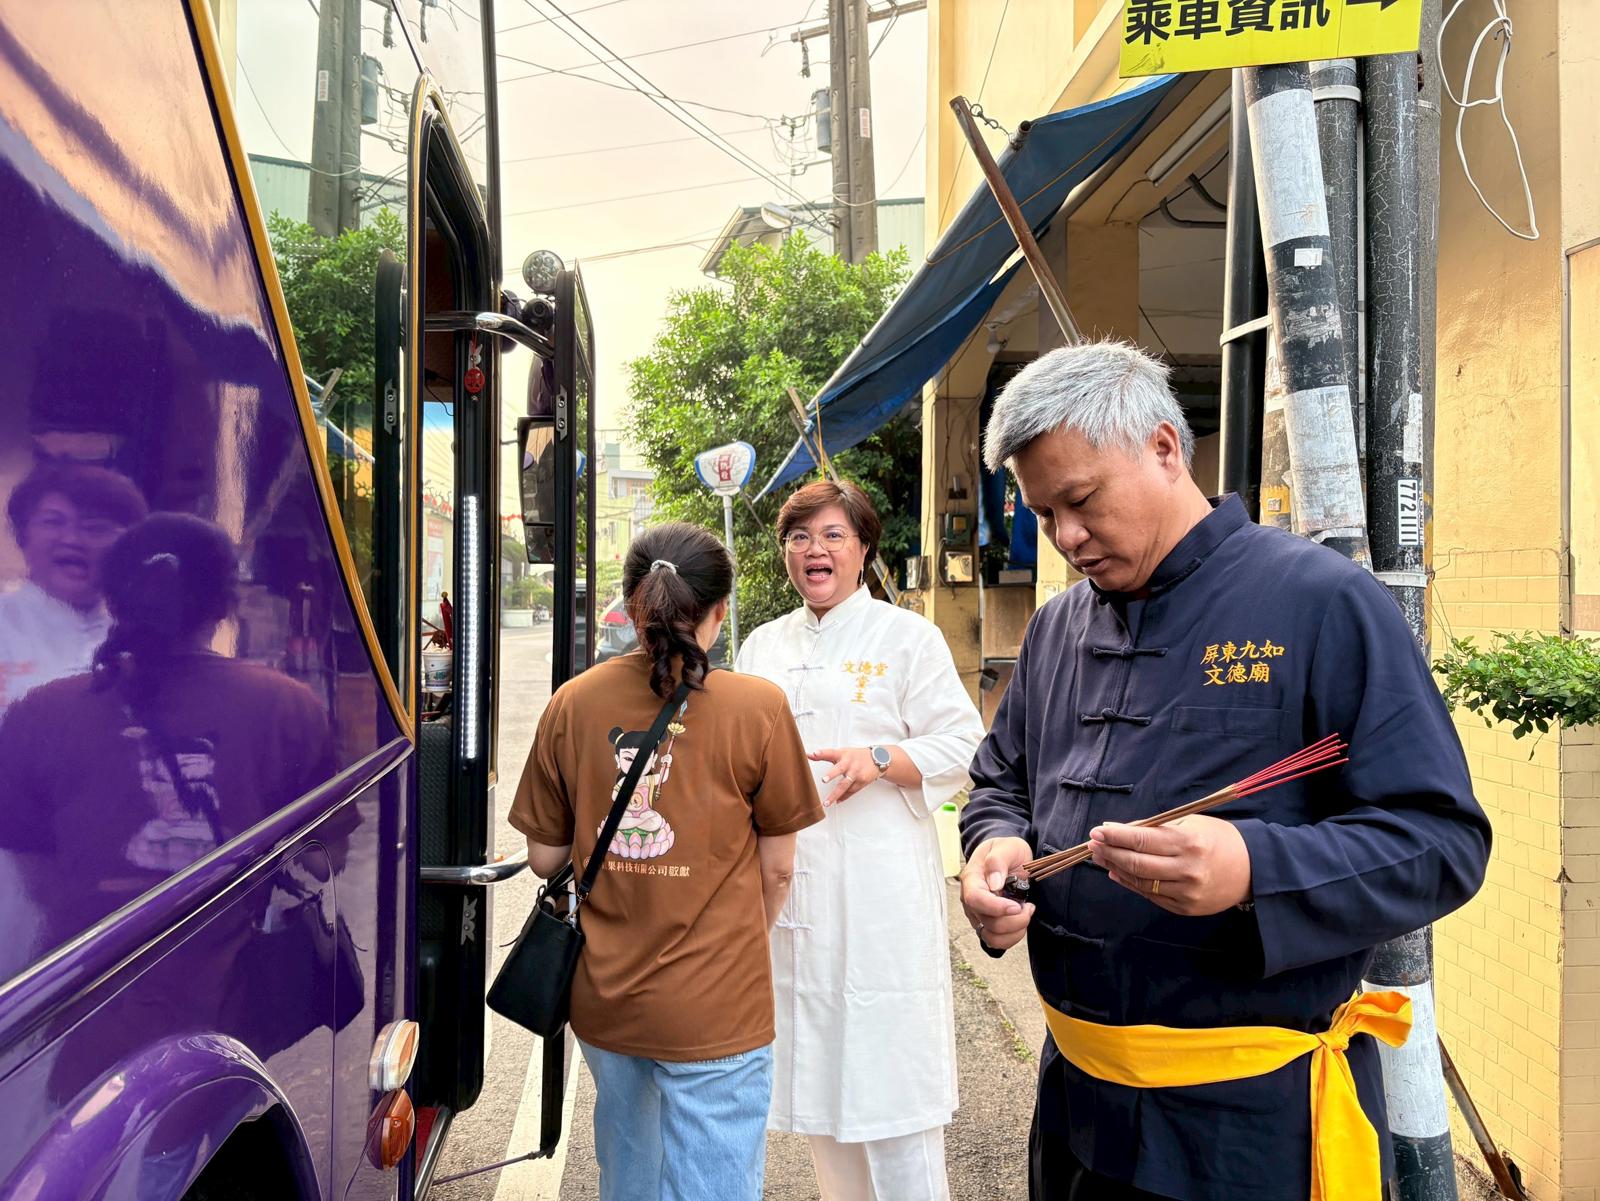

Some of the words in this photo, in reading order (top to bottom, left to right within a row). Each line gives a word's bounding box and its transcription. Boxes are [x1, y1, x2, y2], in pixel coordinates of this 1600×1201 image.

[1125, 0, 1331, 45] 乘車資訊
[1200, 640, 1285, 665] 屏東九如
[1203, 661, 1270, 686] 文德廟
[602, 860, 690, 877] 果科技有限公司敬獻
